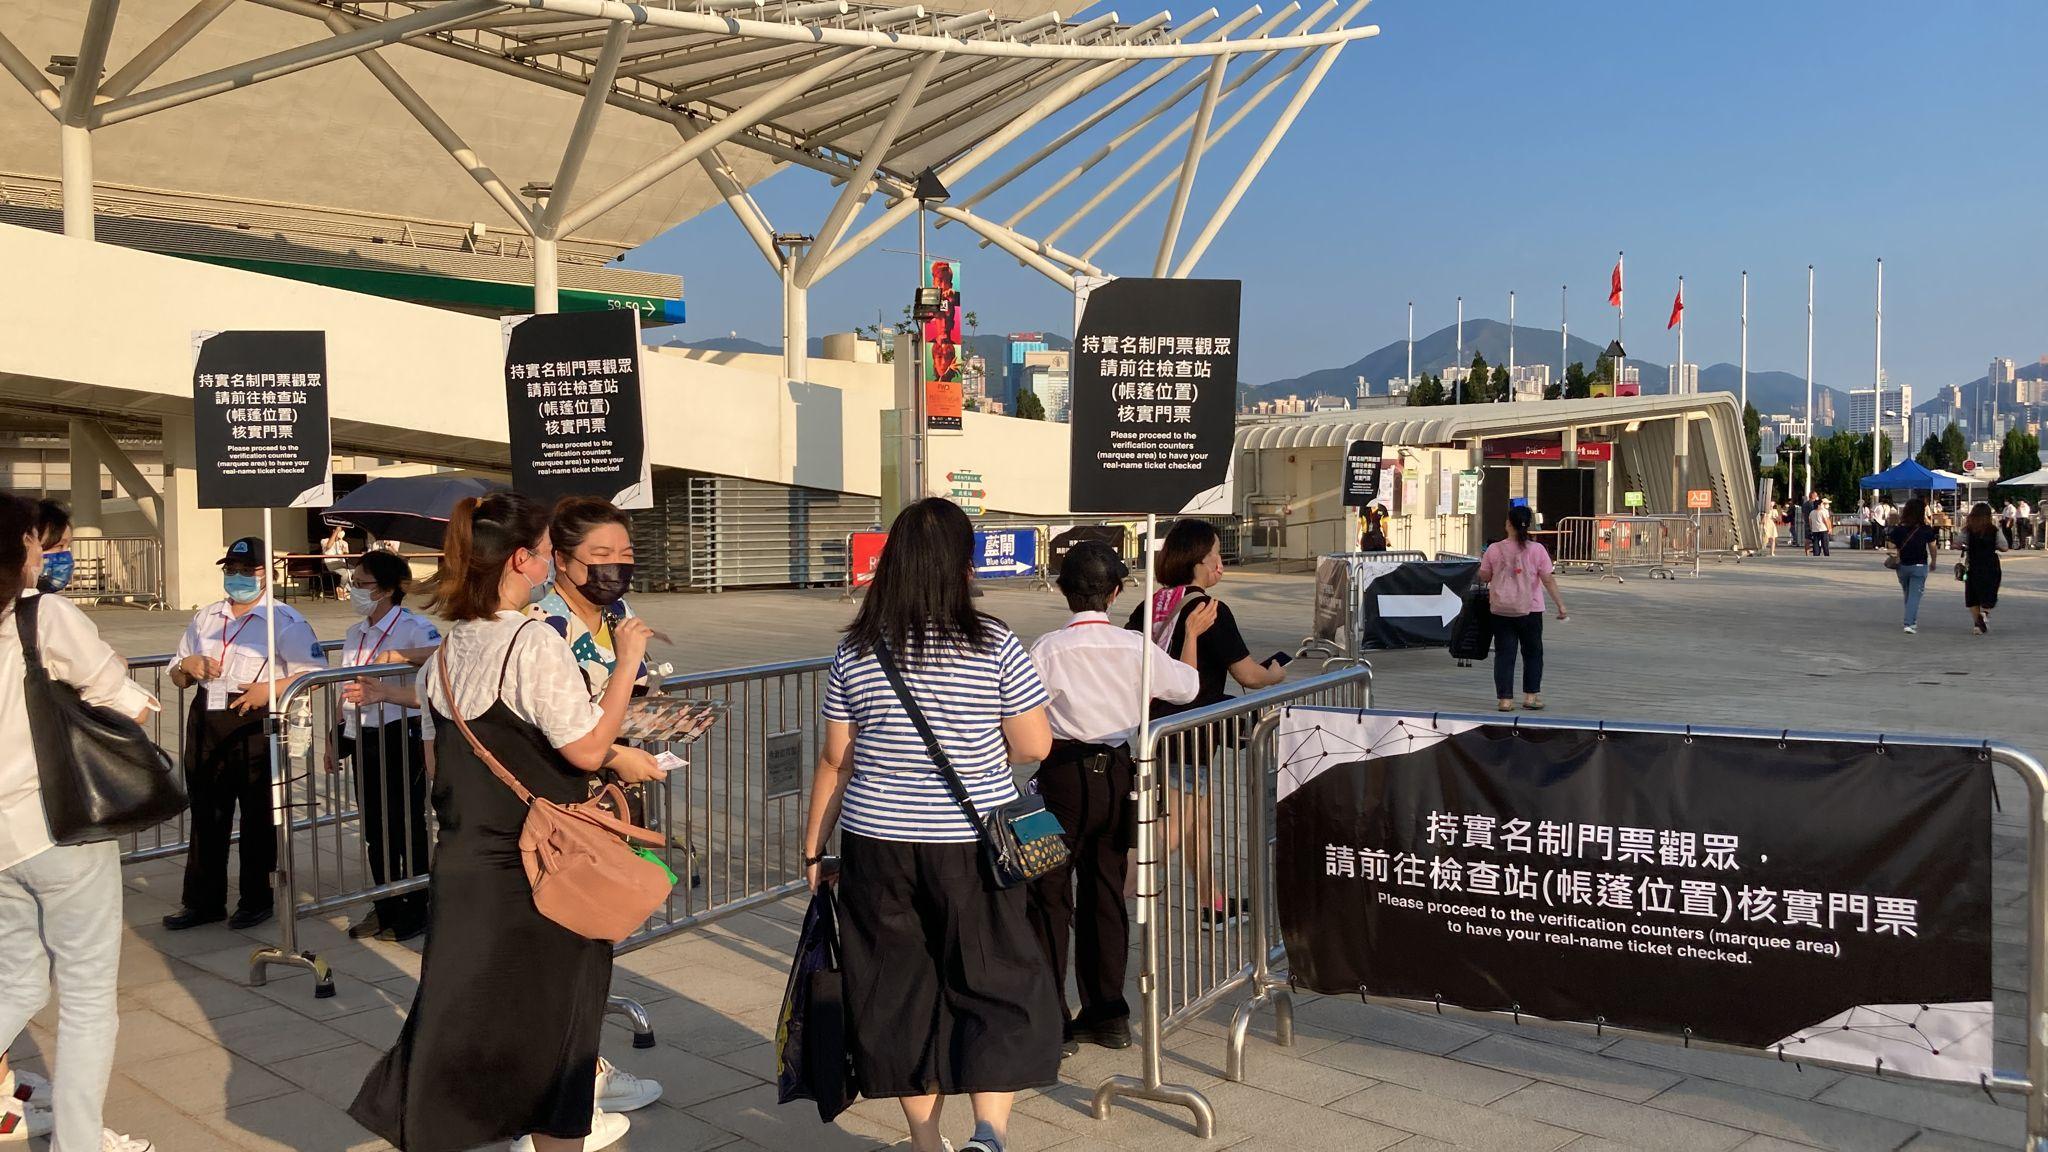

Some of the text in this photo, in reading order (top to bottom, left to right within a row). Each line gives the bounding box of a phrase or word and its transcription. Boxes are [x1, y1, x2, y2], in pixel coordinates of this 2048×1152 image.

[1139, 432, 1171, 440] proceed
[565, 441, 592, 449] proceed
[1097, 452, 1135, 460] (marquee
[1692, 492, 1708, 501] 入口
[986, 557, 1015, 566] Blue Gate
[1378, 892, 1841, 958] Please proceed to the verification counters (marquee area)
[1448, 920, 1752, 964] to have your real-name ticket checked.
